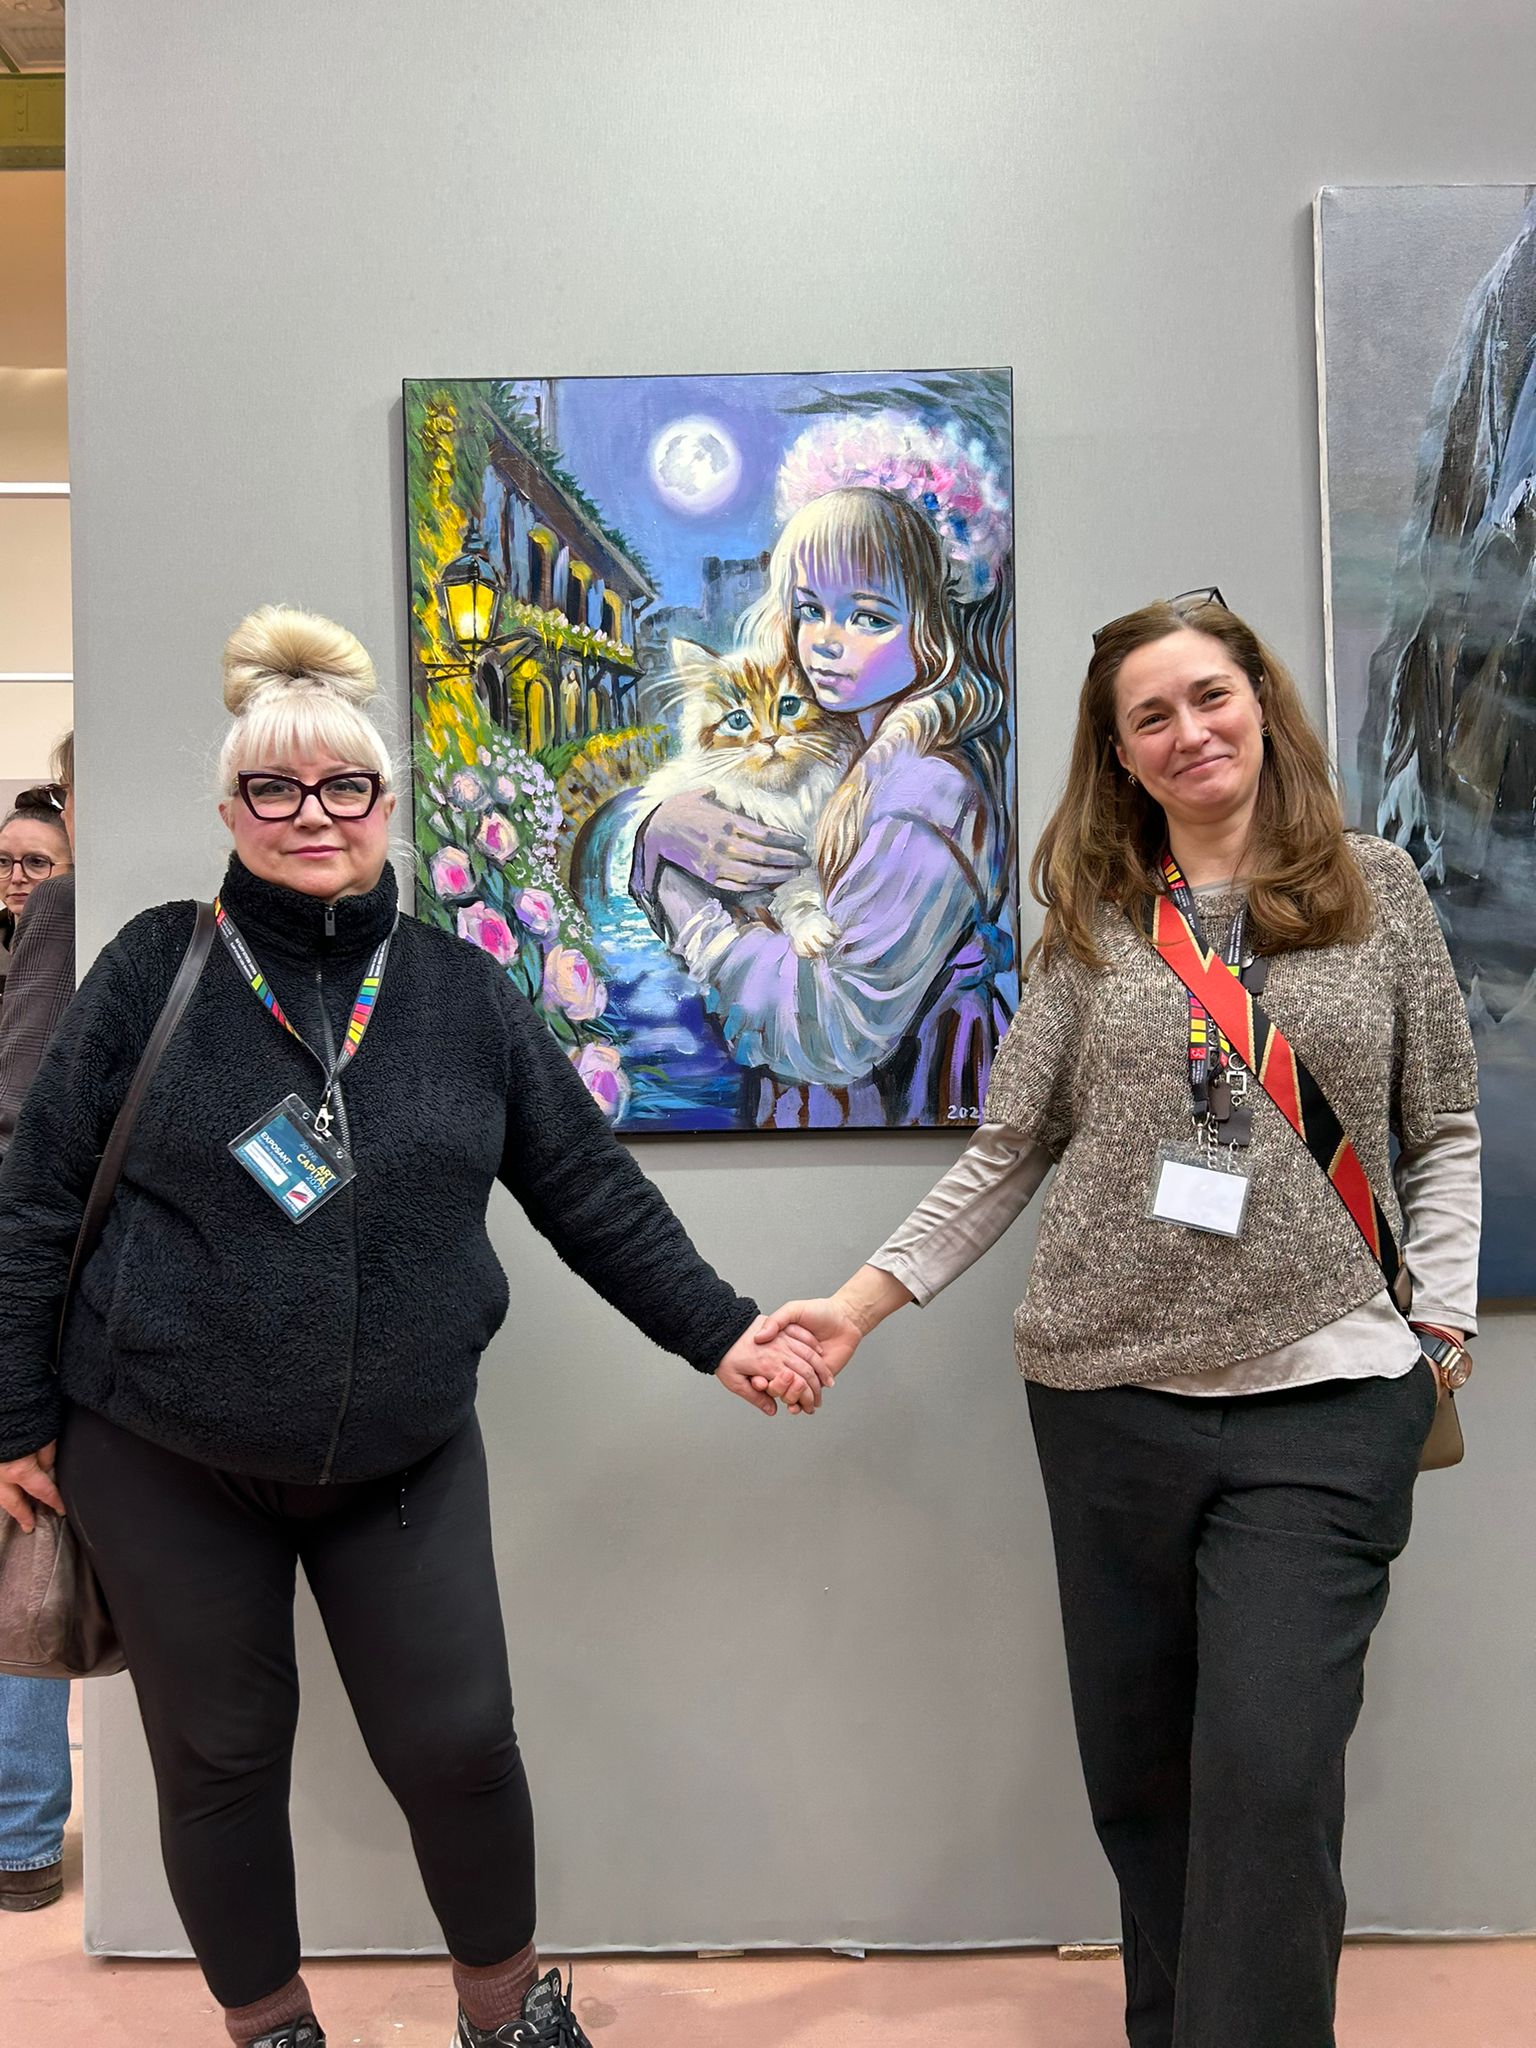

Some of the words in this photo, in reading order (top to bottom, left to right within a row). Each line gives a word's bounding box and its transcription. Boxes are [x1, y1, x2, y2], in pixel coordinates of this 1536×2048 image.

[946, 1104, 980, 1120] 202
[260, 1131, 293, 1165] EXPOSANT
[296, 1153, 330, 1189] CAPITAL
[316, 1165, 337, 1180] ART
